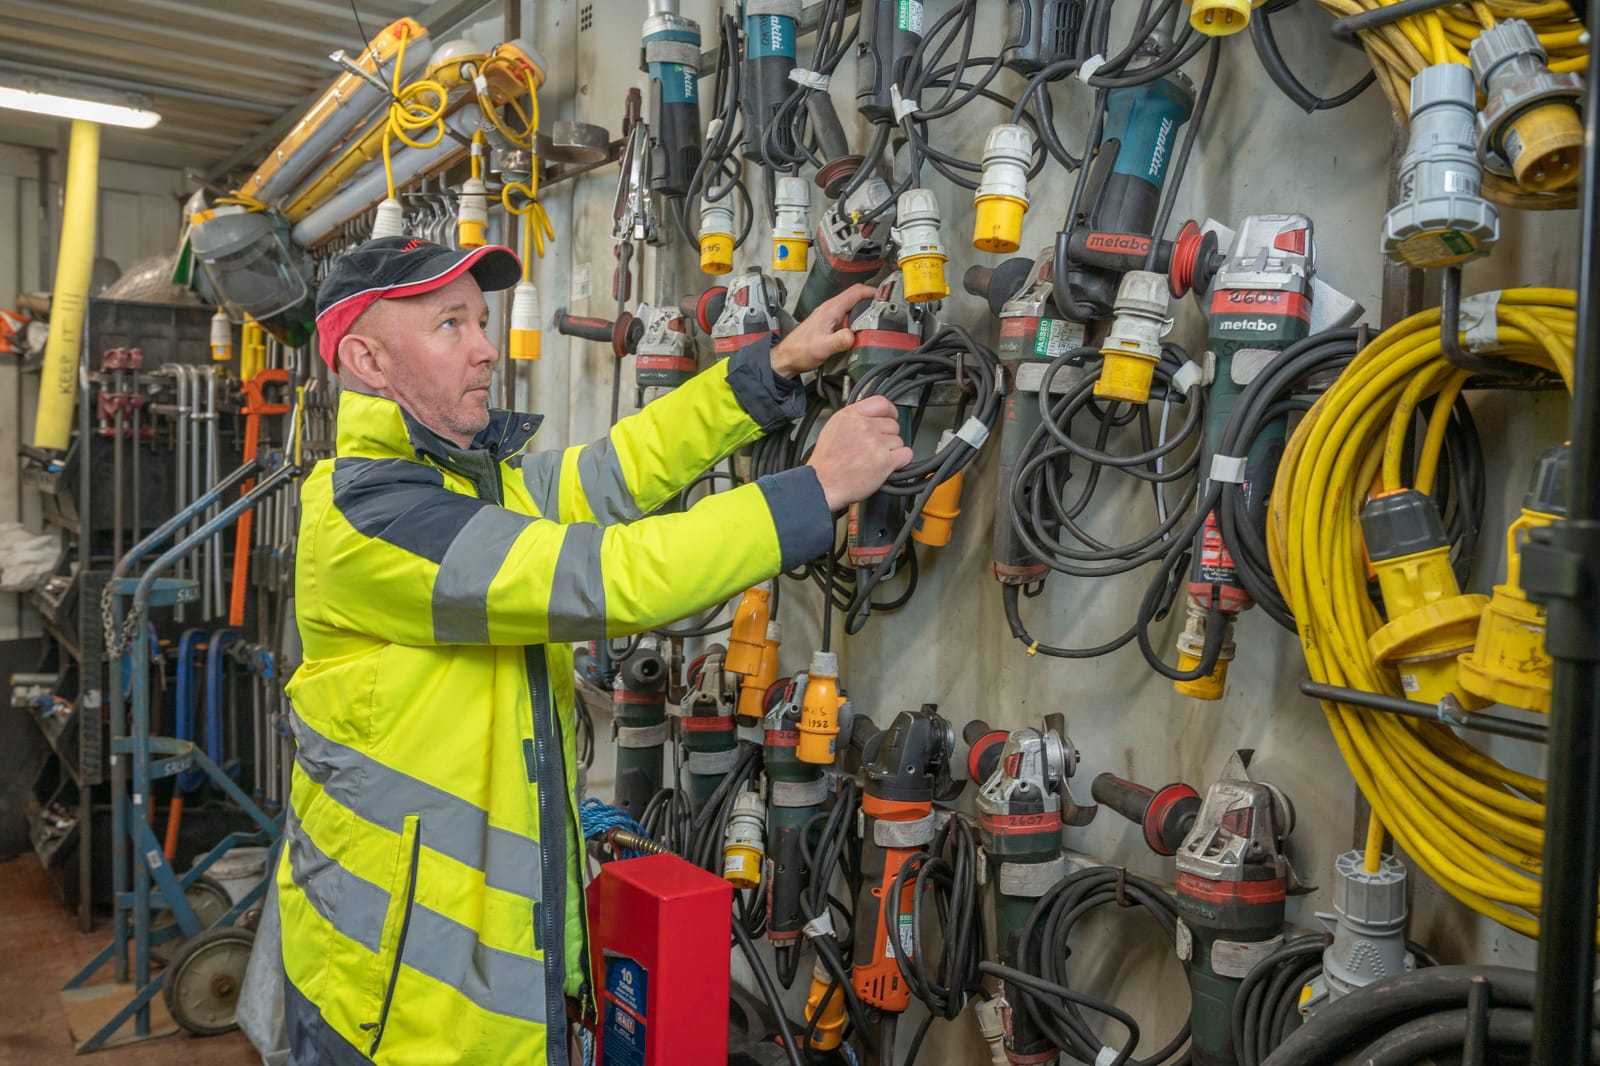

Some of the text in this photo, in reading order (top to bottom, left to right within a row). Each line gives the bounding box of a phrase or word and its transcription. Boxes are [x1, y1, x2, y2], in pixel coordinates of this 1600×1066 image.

[770, 15, 783, 51] akita
[684, 69, 695, 98] kita
[1090, 236, 1151, 251] metabo
[1036, 320, 1048, 352] PASSED
[1219, 319, 1278, 332] metabo
[57, 355, 74, 395] KEEP
[1009, 815, 1043, 827] 2607
[621, 967, 633, 985] 10
